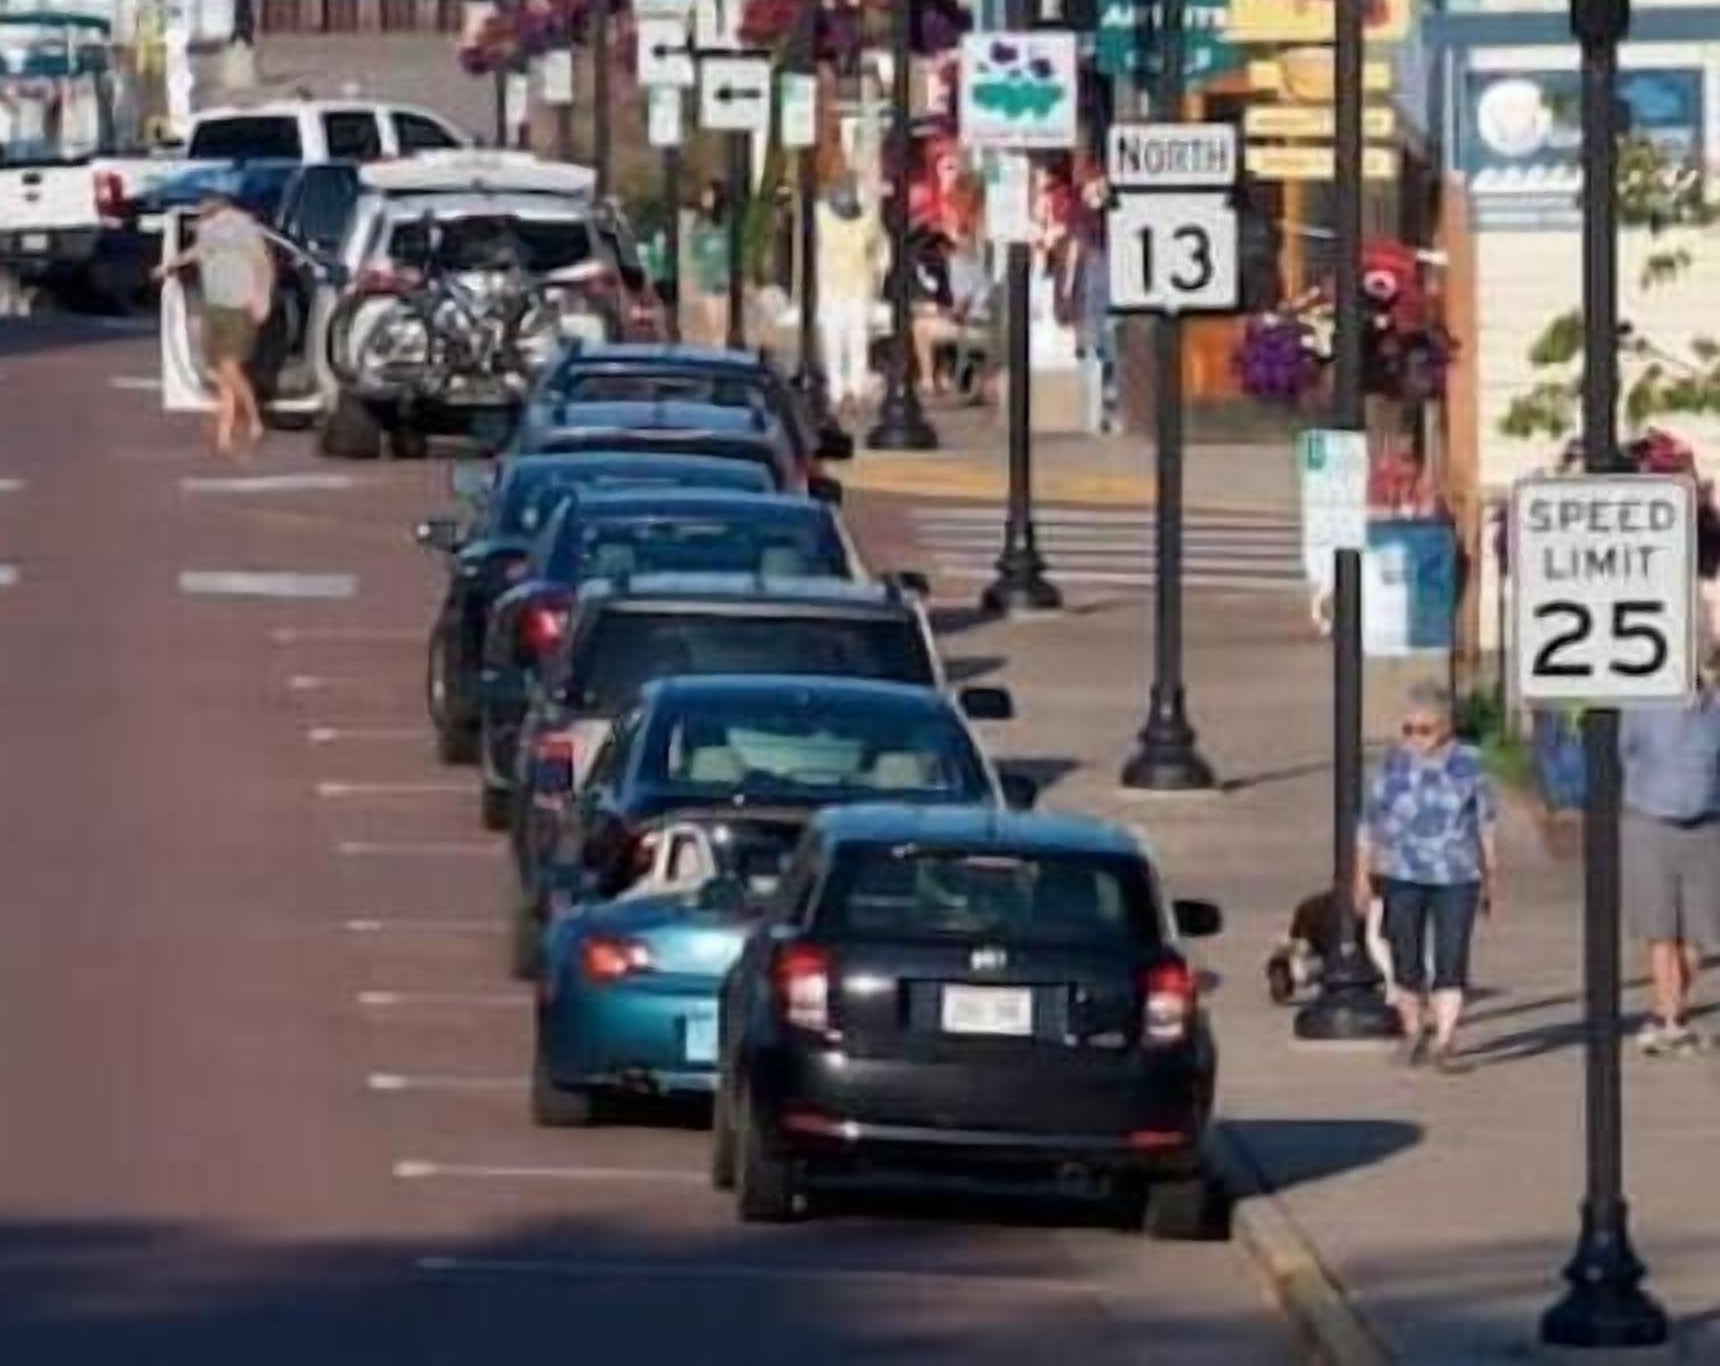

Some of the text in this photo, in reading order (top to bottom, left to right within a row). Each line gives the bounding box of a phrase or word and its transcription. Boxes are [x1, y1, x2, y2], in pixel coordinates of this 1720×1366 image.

[1118, 136, 1227, 174] NORTH
[1136, 223, 1214, 294] 13
[1528, 498, 1676, 533] SPEED
[1543, 546, 1661, 580] LIMIT
[1532, 598, 1668, 677] 25
